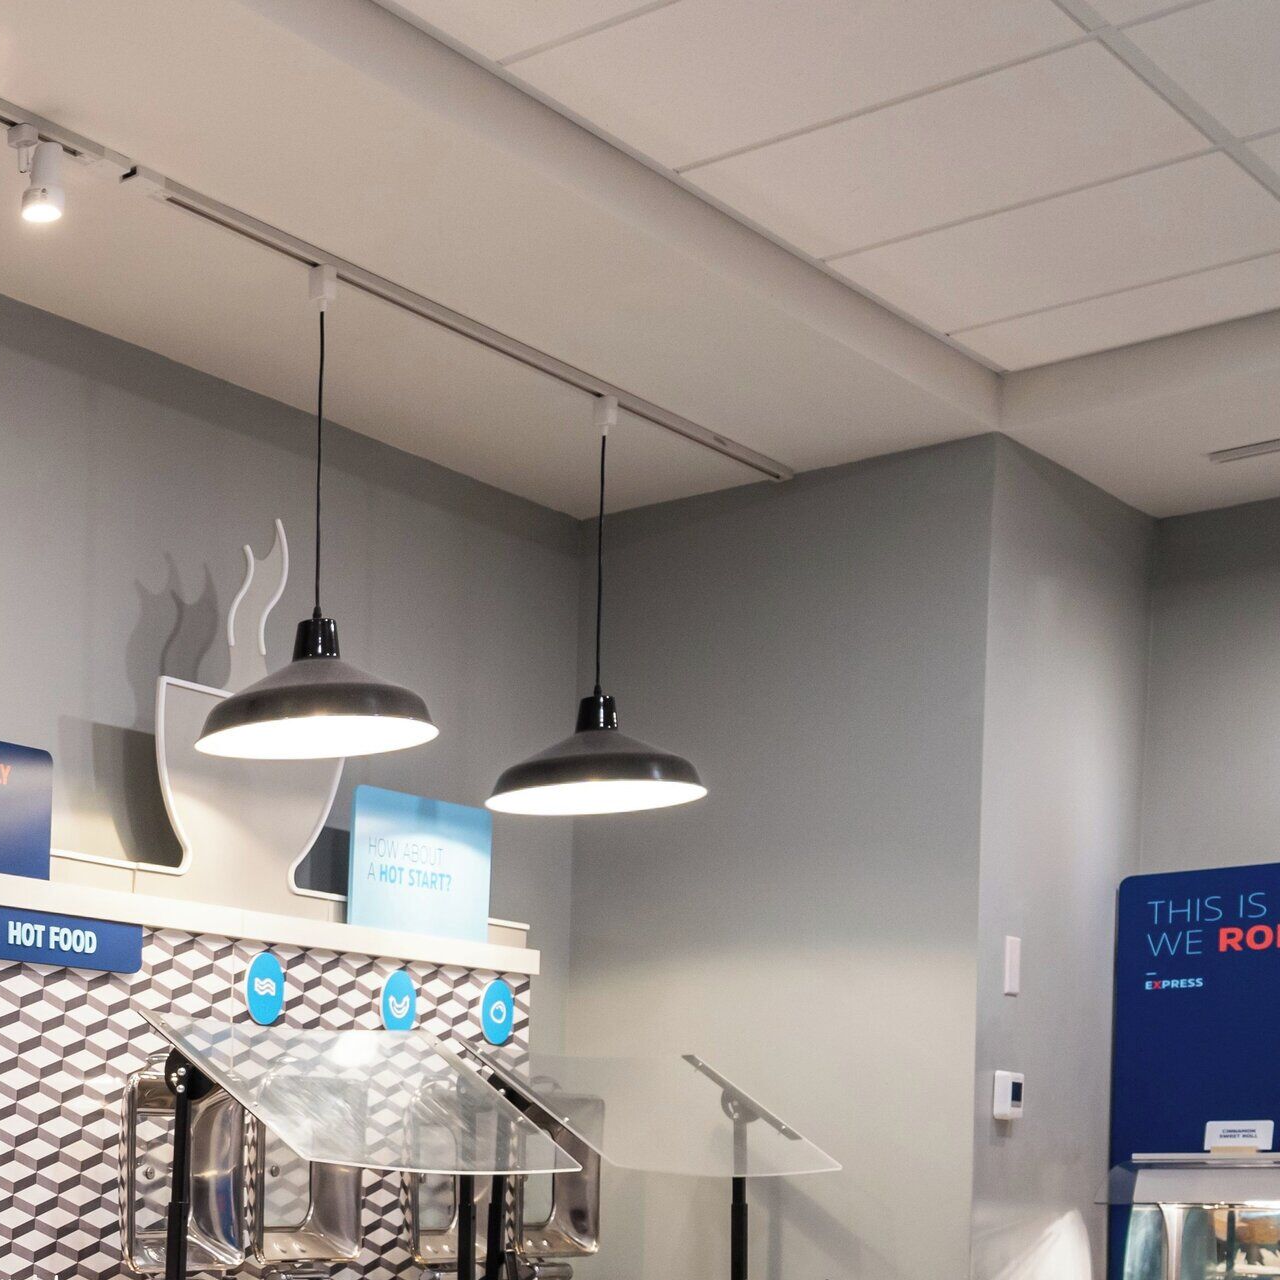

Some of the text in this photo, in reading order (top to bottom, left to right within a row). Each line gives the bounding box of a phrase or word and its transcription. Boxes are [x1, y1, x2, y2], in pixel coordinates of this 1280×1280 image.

[368, 835, 444, 866] HOW ABOUT
[367, 862, 452, 892] A HOT START?
[1147, 892, 1268, 925] THIS IS
[7, 920, 98, 954] HOT FOOD
[1147, 924, 1280, 957] WE RO
[1144, 977, 1204, 991] EXPRESS
